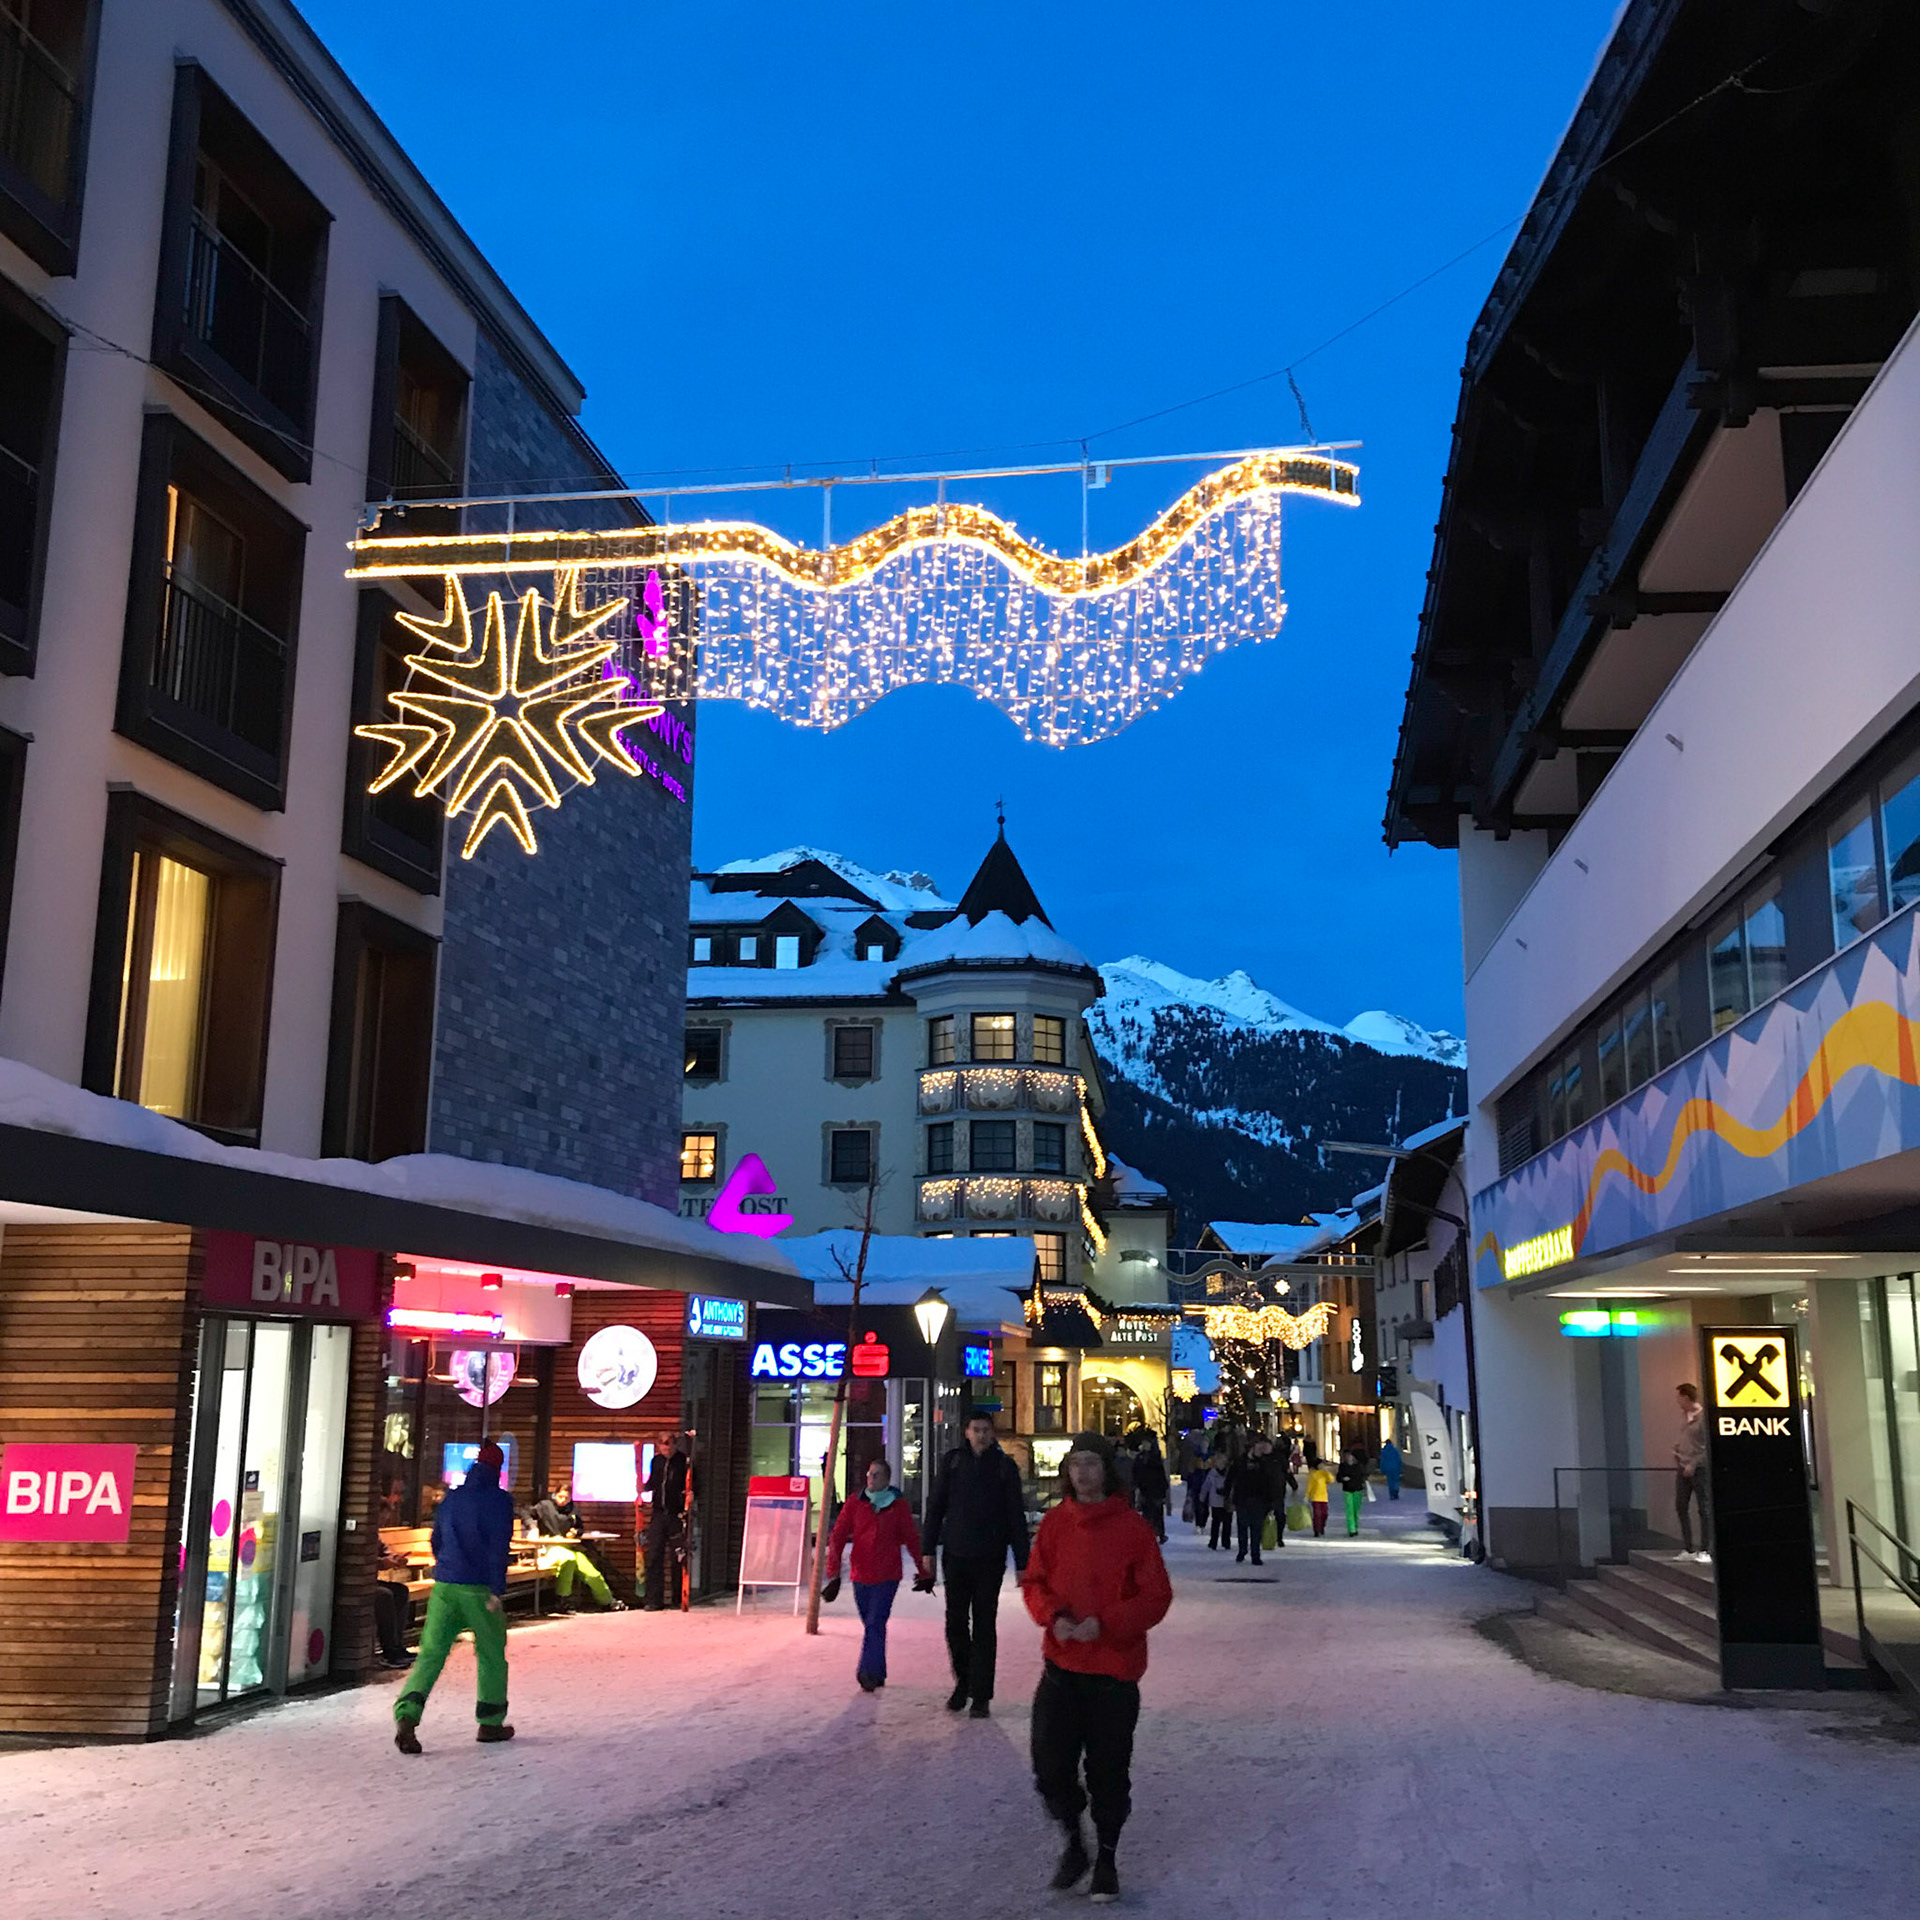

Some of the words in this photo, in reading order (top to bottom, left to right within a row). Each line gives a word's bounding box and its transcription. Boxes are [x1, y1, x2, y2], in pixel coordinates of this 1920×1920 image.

[251, 1240, 340, 1306] BIPA
[1118, 1319, 1149, 1330] HOTEL
[1110, 1331, 1133, 1342] ALTE
[1135, 1331, 1158, 1342] POST
[1718, 1417, 1791, 1436] BANK
[6, 1471, 123, 1514] BIPA
